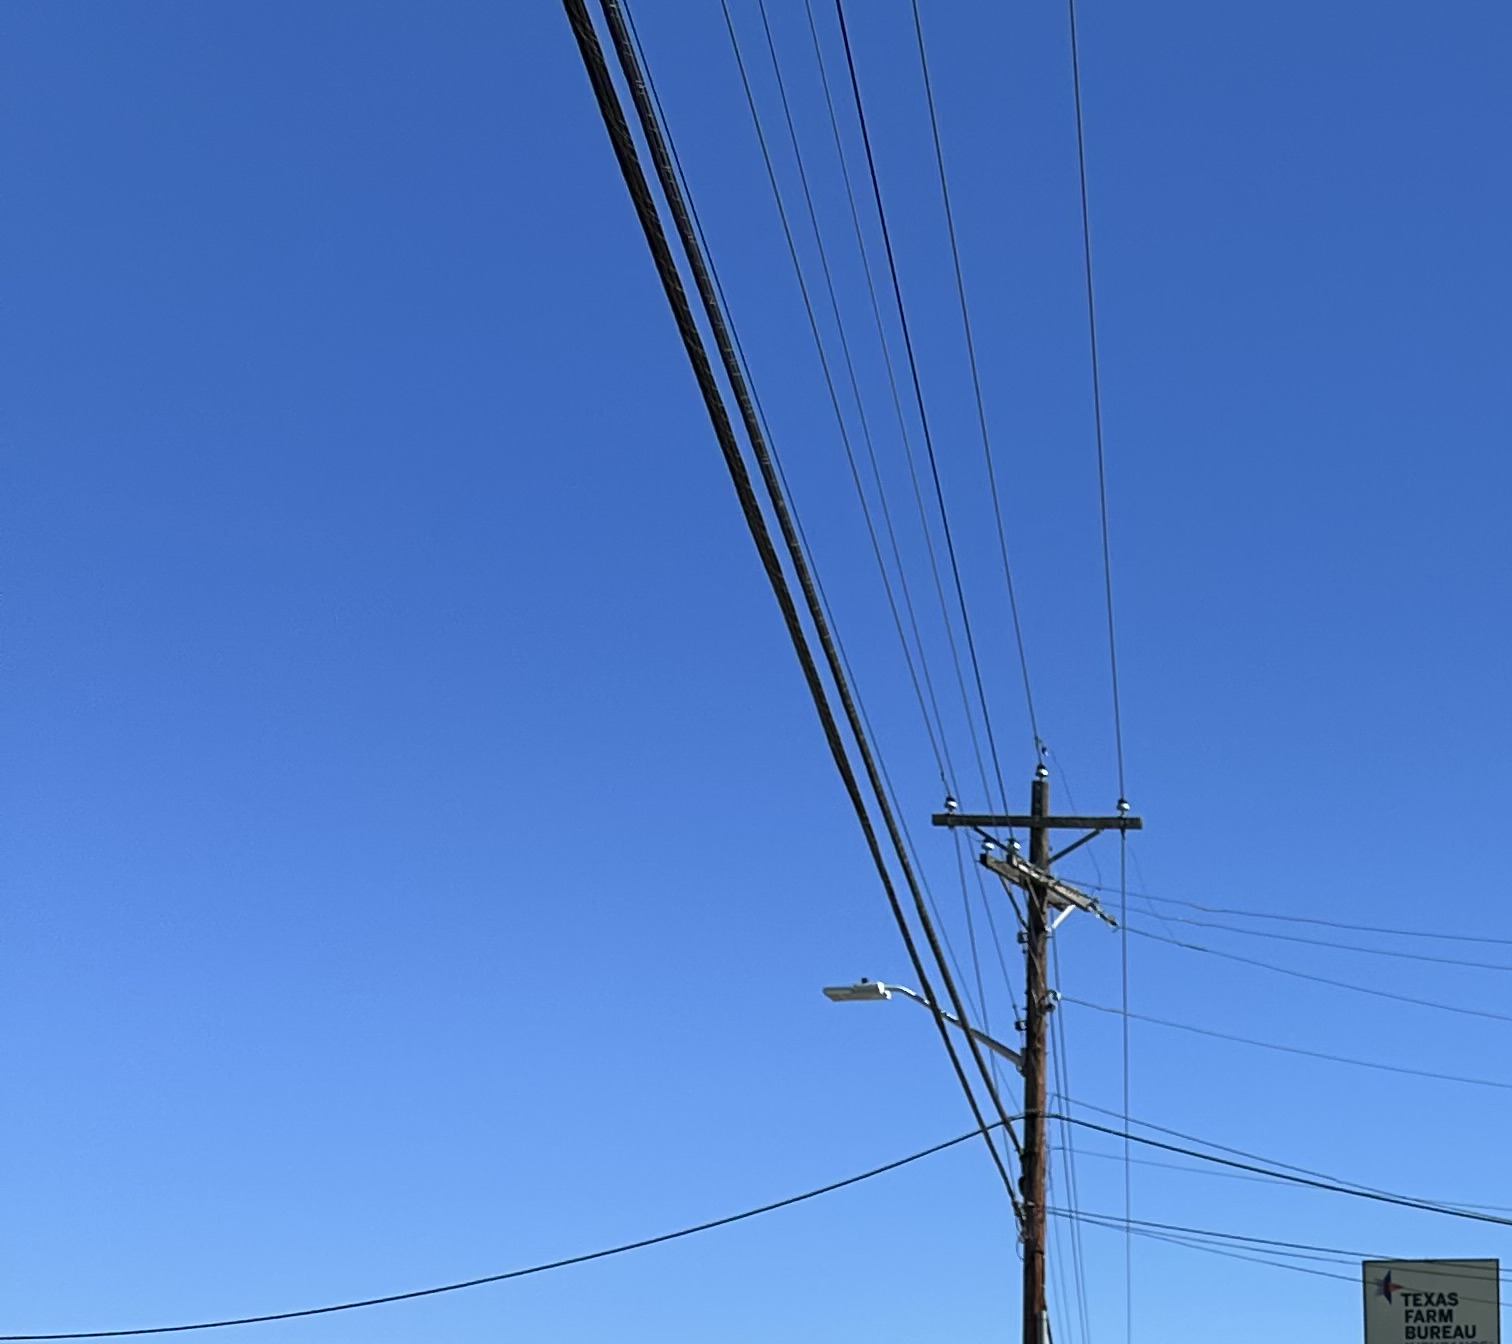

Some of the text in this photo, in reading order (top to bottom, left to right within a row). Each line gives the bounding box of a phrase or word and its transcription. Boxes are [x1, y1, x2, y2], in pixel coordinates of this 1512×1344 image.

[1401, 1292, 1458, 1307] TEXAS
[1404, 1309, 1453, 1323] FARM
[1405, 1325, 1476, 1340] BUREAU
